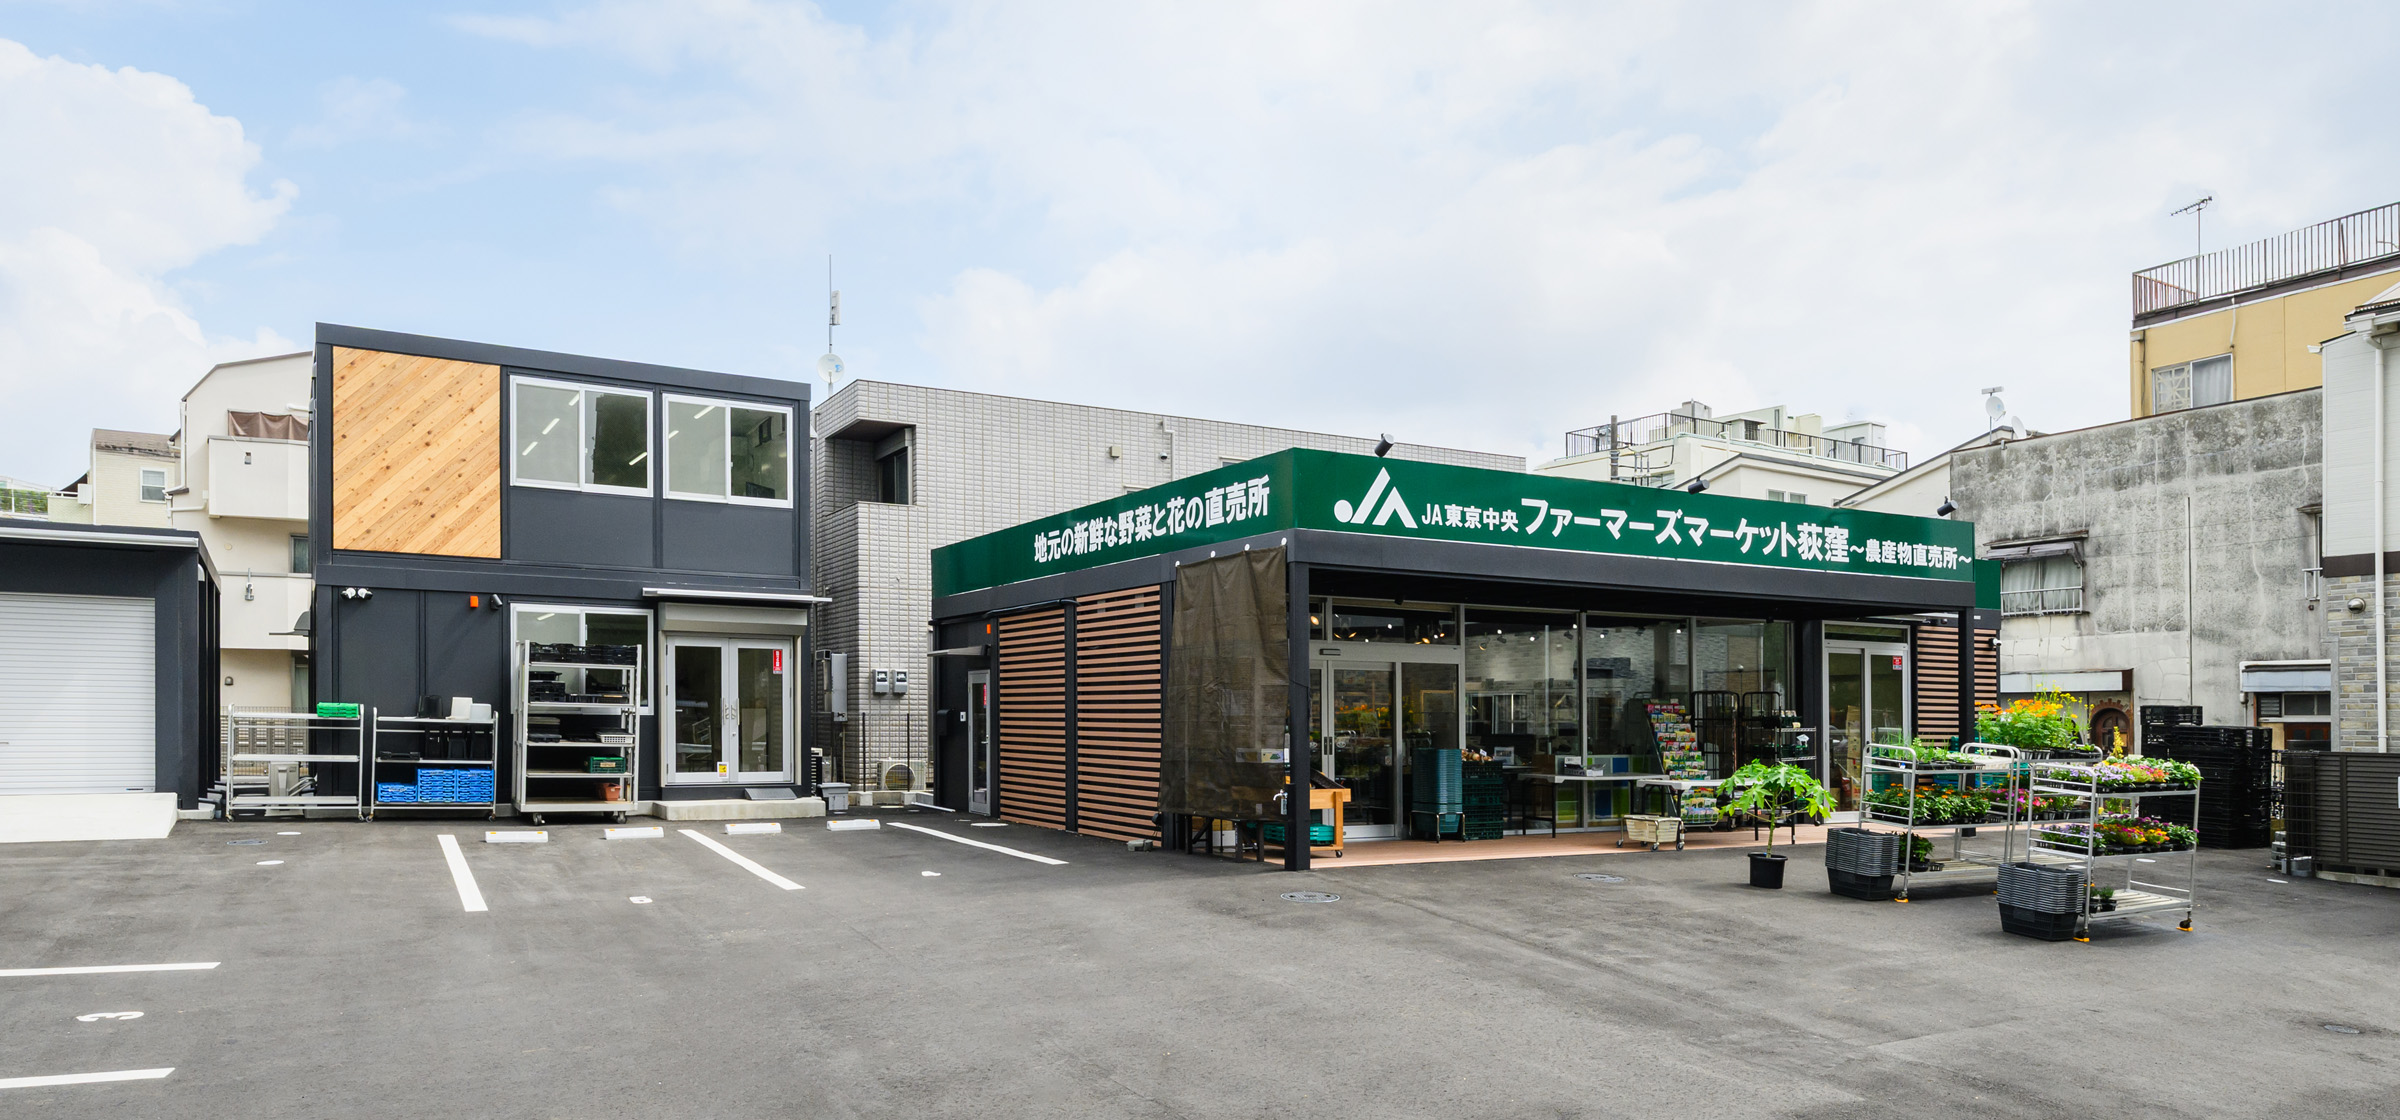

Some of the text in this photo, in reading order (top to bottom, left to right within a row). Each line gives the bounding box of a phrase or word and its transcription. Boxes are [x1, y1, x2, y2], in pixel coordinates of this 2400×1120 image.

[1034, 474, 1270, 563] 地元の新鮮な野菜と花の直売所
